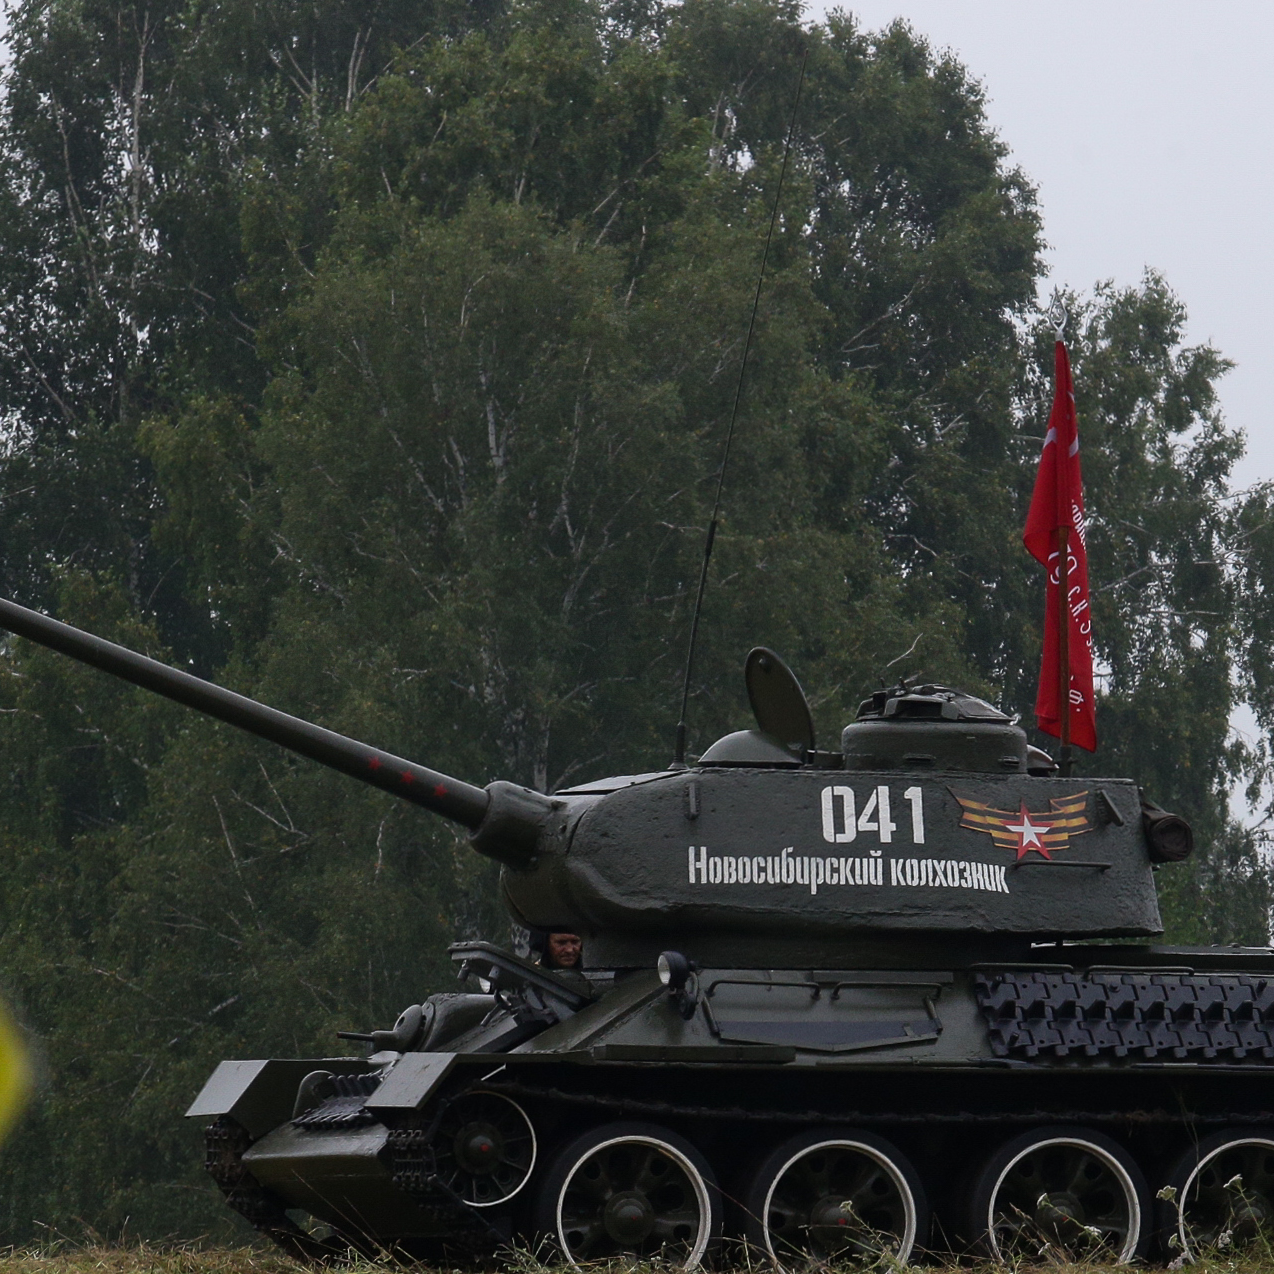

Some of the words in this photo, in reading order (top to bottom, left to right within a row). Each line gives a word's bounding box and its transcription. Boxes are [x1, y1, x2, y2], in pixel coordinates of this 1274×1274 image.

[820, 785, 925, 844] 041
[688, 846, 884, 895] Новосибирский
[890, 857, 1010, 894] колхозник
